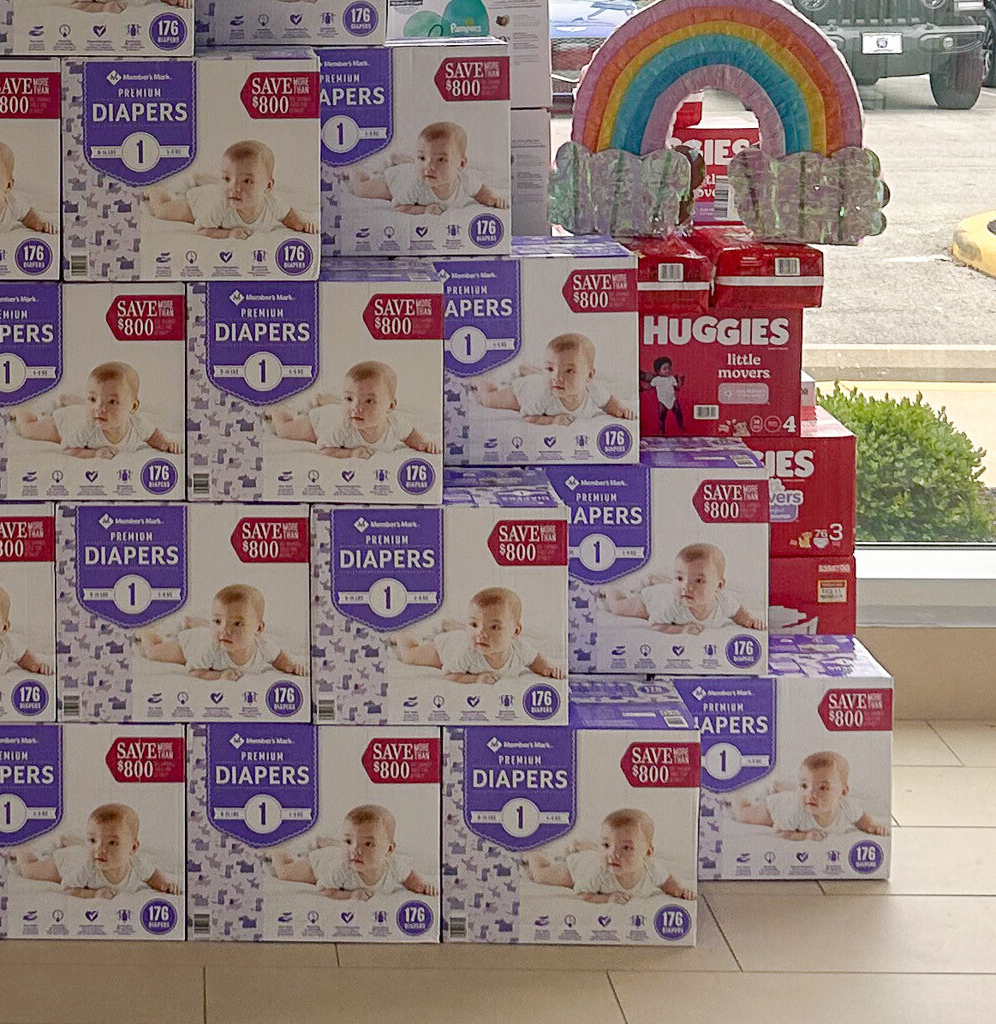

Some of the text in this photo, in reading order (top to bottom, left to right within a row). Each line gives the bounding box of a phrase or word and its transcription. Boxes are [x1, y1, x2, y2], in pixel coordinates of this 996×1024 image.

[157, 20, 179, 36] 176
[450, 22, 482, 34] Pampers
[319, 73, 360, 84] PREMIUM
[444, 60, 483, 79] SAVE
[251, 77, 292, 95] SAVE
[444, 78, 480, 97] $800
[92, 101, 188, 123] DIAPERS
[251, 95, 289, 115] $800
[337, 122, 344, 146] 1
[476, 219, 497, 235] 176
[23, 245, 45, 261] 176
[572, 273, 611, 291] SAVE
[117, 299, 157, 317] SAVE
[374, 298, 415, 316] SAVE
[573, 290, 609, 309] $800
[240, 308, 284, 318] PREMIUM
[117, 317, 154, 337] $800
[215, 322, 311, 342] DIAPERS
[374, 316, 412, 336] $800
[643, 315, 790, 346] HUGGIES
[727, 353, 761, 366] little
[259, 359, 266, 383] 1
[718, 368, 771, 379] movers
[782, 415, 797, 433] 4
[406, 465, 428, 481] 176
[576, 492, 617, 502] PREMIUM
[703, 484, 743, 501] SAVE
[703, 501, 739, 519] $800
[241, 522, 281, 540] SAVE
[499, 524, 540, 543] SAVE
[829, 523, 843, 541] 3
[85, 545, 179, 566] DIAPERS
[241, 540, 278, 559] $800
[340, 548, 435, 569] DIAPERS
[499, 542, 536, 562] $800
[593, 540, 600, 564] 1
[733, 641, 754, 656] 176
[19, 686, 41, 703] 176
[828, 692, 866, 710] SAVE
[703, 702, 744, 712] PREMIUM
[828, 709, 863, 727] $800
[117, 742, 157, 759] SAVE
[241, 751, 284, 761] PREMIUM
[373, 742, 414, 760] SAVE
[632, 746, 673, 764] SAVE
[117, 760, 154, 778] $800
[373, 760, 410, 779] $800
[719, 749, 727, 772] 1
[215, 765, 310, 785] DIAPERS
[473, 769, 568, 789] DIAPERS
[631, 764, 669, 783] $800
[259, 801, 266, 826] 1
[856, 846, 876, 861] 176
[404, 907, 426, 923] 176
